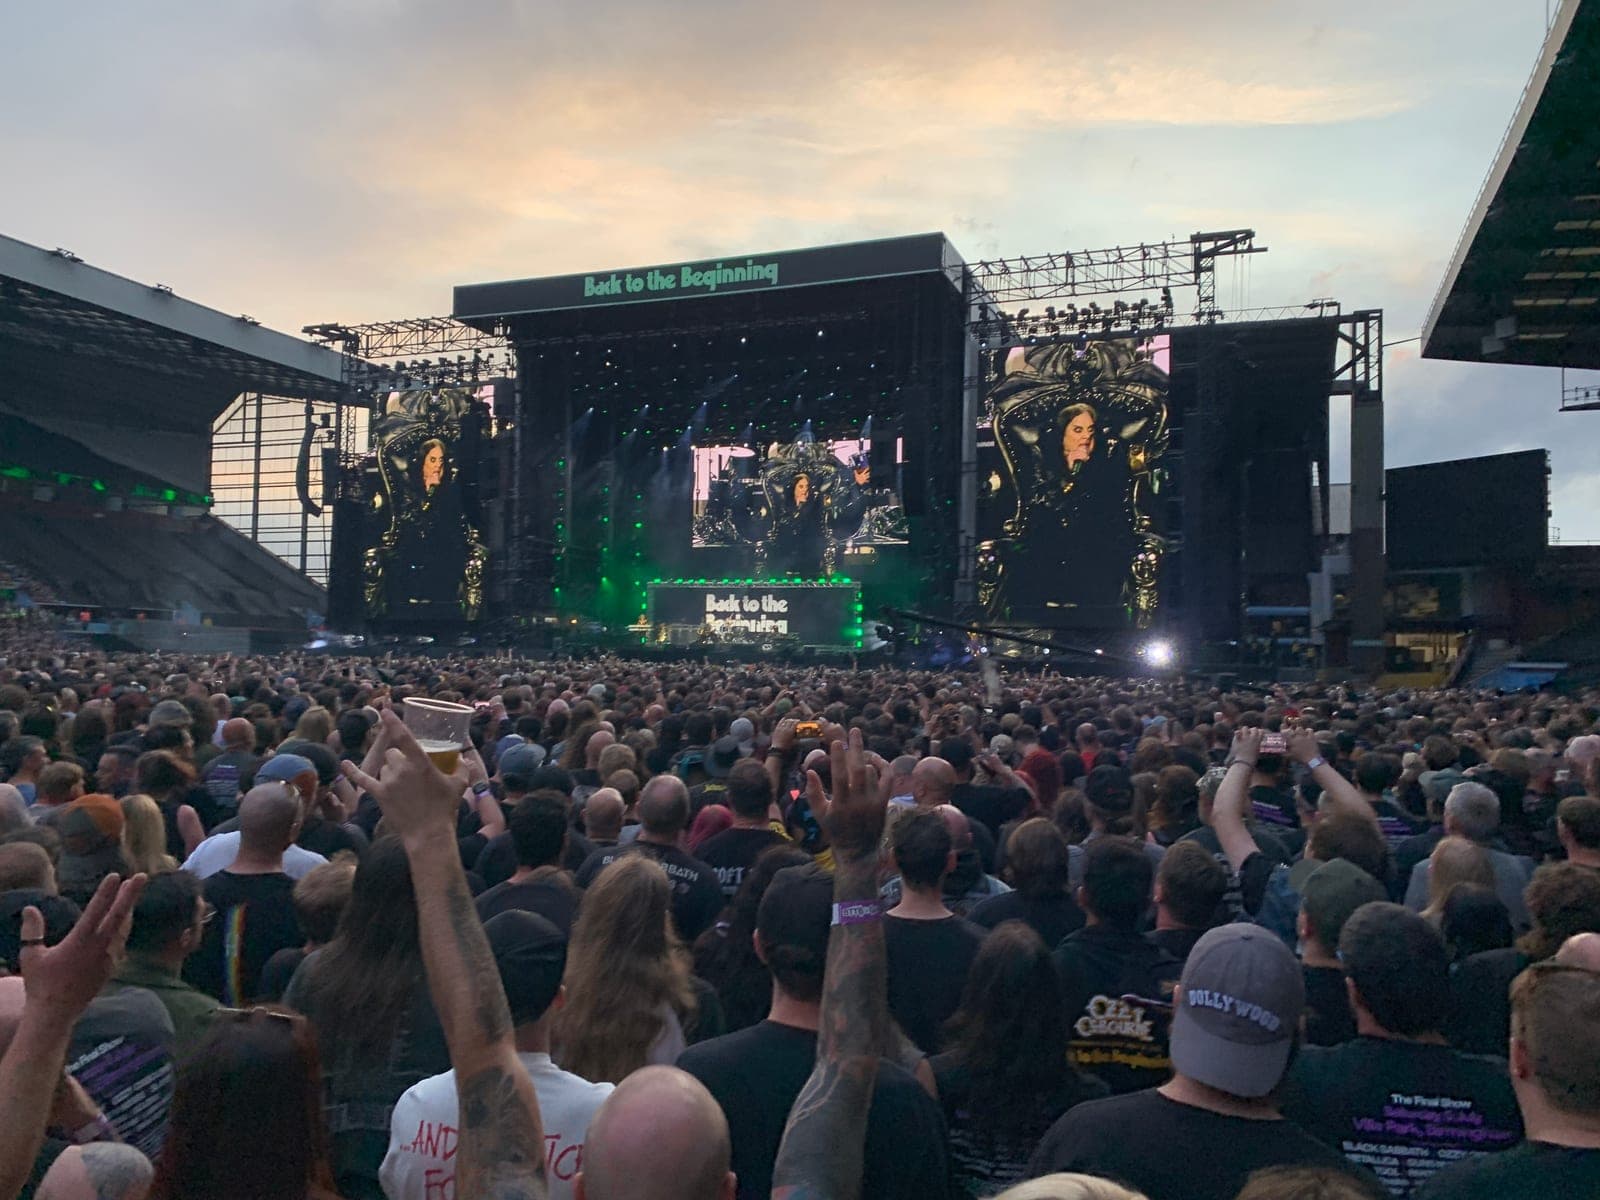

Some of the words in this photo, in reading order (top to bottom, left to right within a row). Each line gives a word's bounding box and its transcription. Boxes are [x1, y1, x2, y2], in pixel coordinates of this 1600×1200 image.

[584, 274, 622, 297] Back
[626, 273, 644, 293] to
[647, 270, 676, 291] the
[681, 260, 779, 291] Beginning
[706, 594, 740, 612] Back
[743, 595, 760, 612] to
[762, 594, 788, 612] the
[1391, 1094, 1413, 1105] The
[1414, 1095, 1439, 1107] Final
[1441, 1098, 1472, 1109] Show
